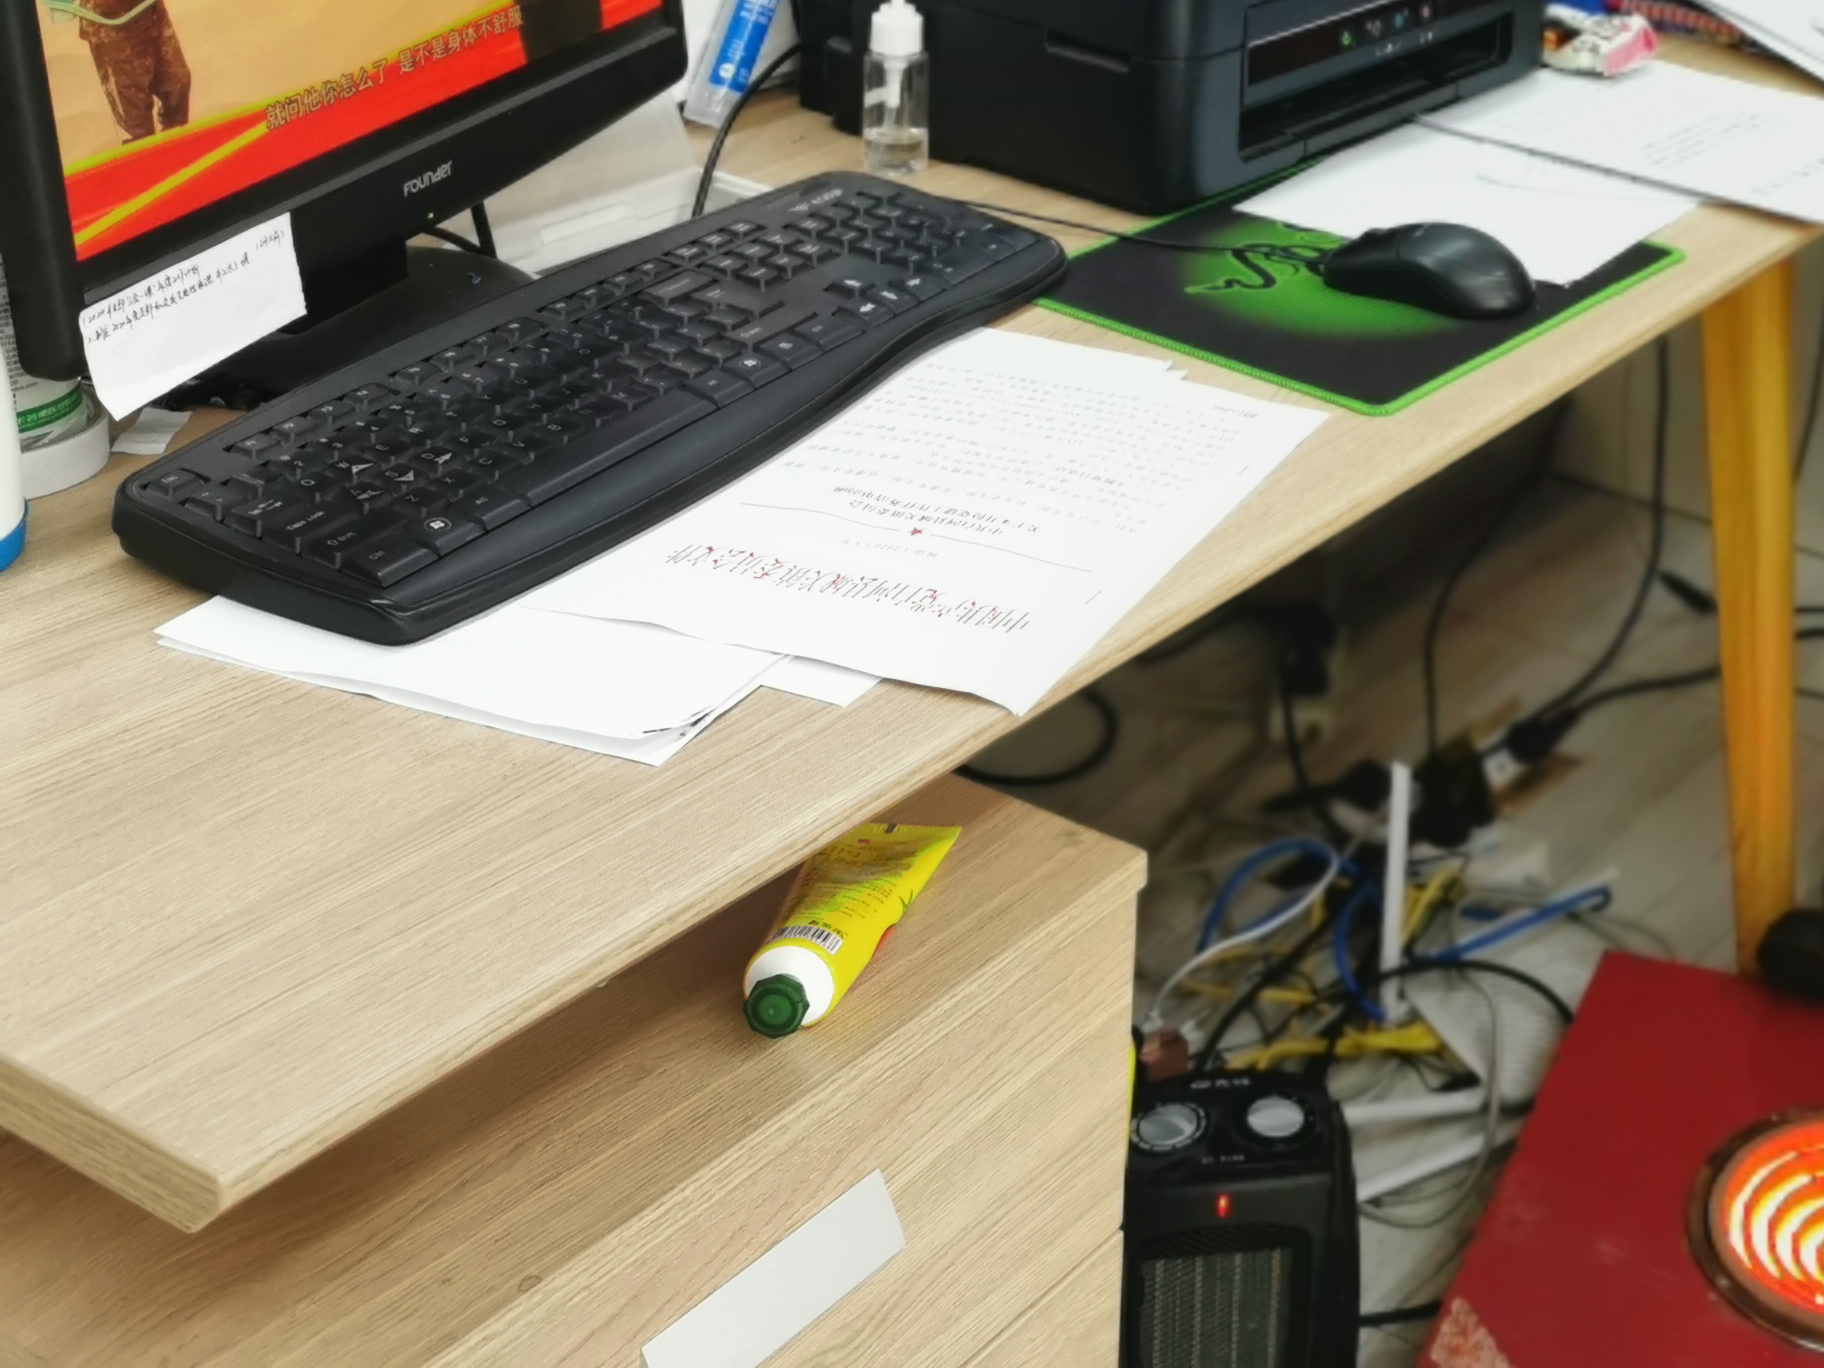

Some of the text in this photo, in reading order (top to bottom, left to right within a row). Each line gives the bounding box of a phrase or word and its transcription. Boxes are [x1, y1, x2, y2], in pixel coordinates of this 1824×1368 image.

[265, 5, 524, 130] 就问他你怎么了 是不是身体不舒服
